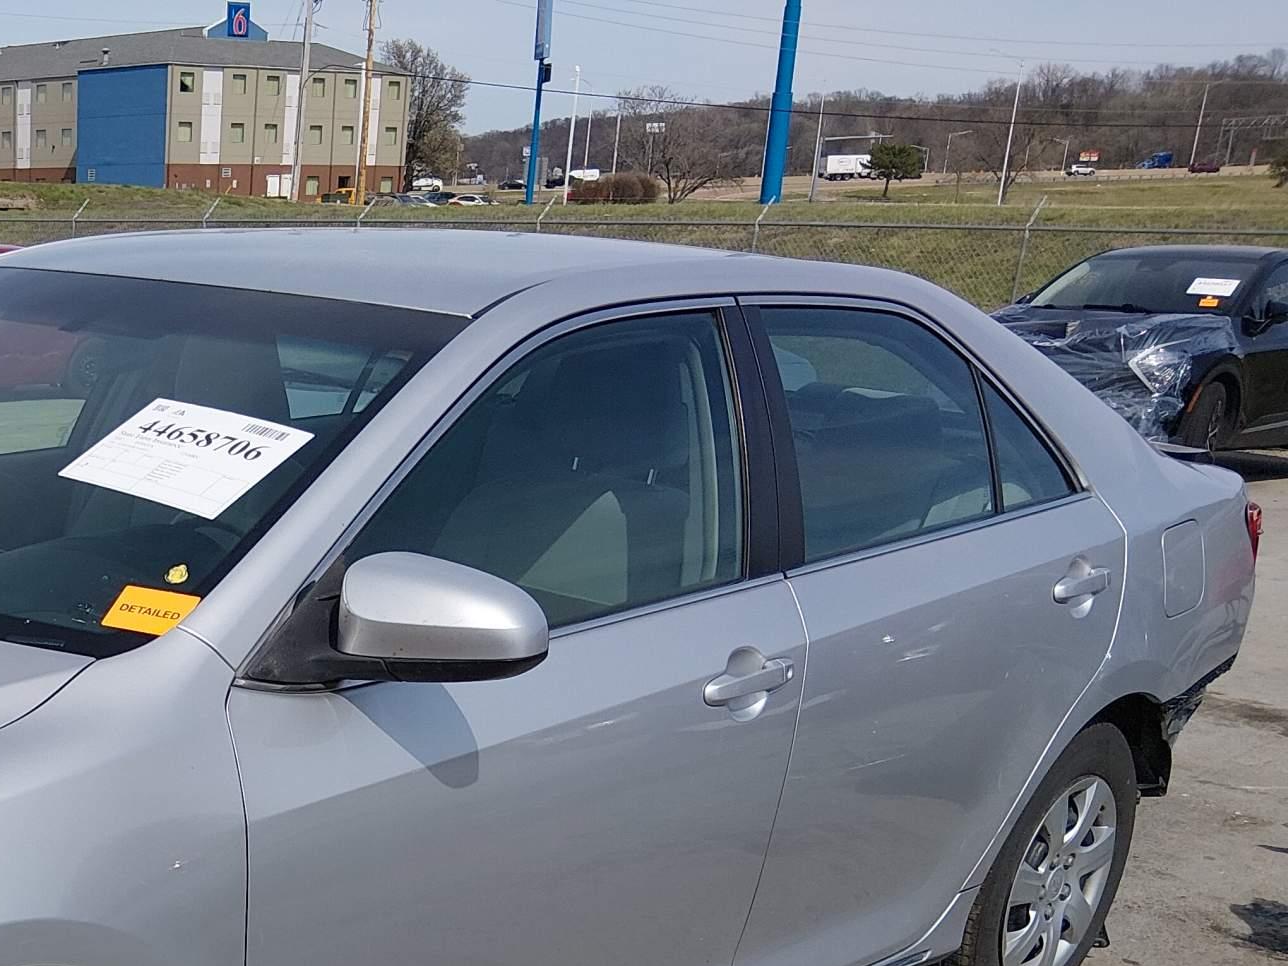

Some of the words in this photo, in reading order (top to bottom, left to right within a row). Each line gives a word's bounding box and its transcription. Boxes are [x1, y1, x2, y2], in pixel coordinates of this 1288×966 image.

[233, 8, 247, 35] 6
[138, 420, 270, 461] 44658706
[119, 603, 181, 620] DETAILED
